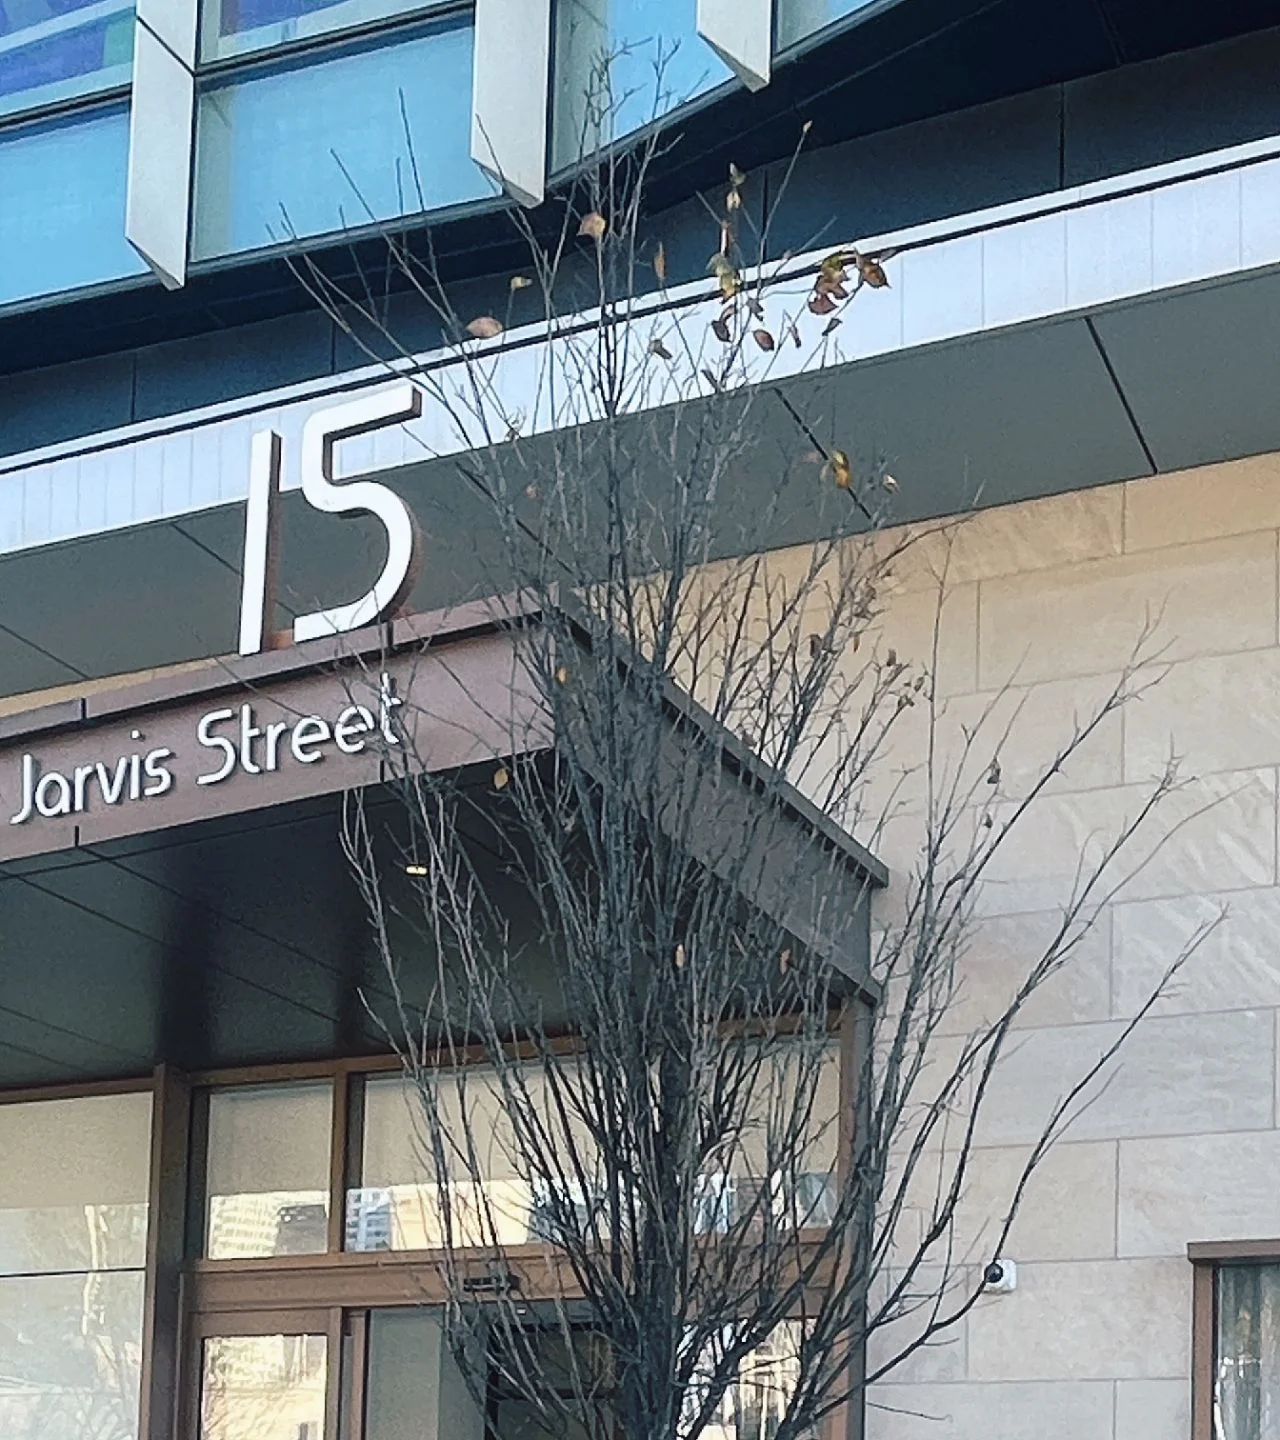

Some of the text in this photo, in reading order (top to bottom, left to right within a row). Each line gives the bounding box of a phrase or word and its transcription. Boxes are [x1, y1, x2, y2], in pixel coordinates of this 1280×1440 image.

[238, 384, 420, 656] 15
[10, 729, 172, 825] Jarvis
[197, 672, 402, 785] Street
